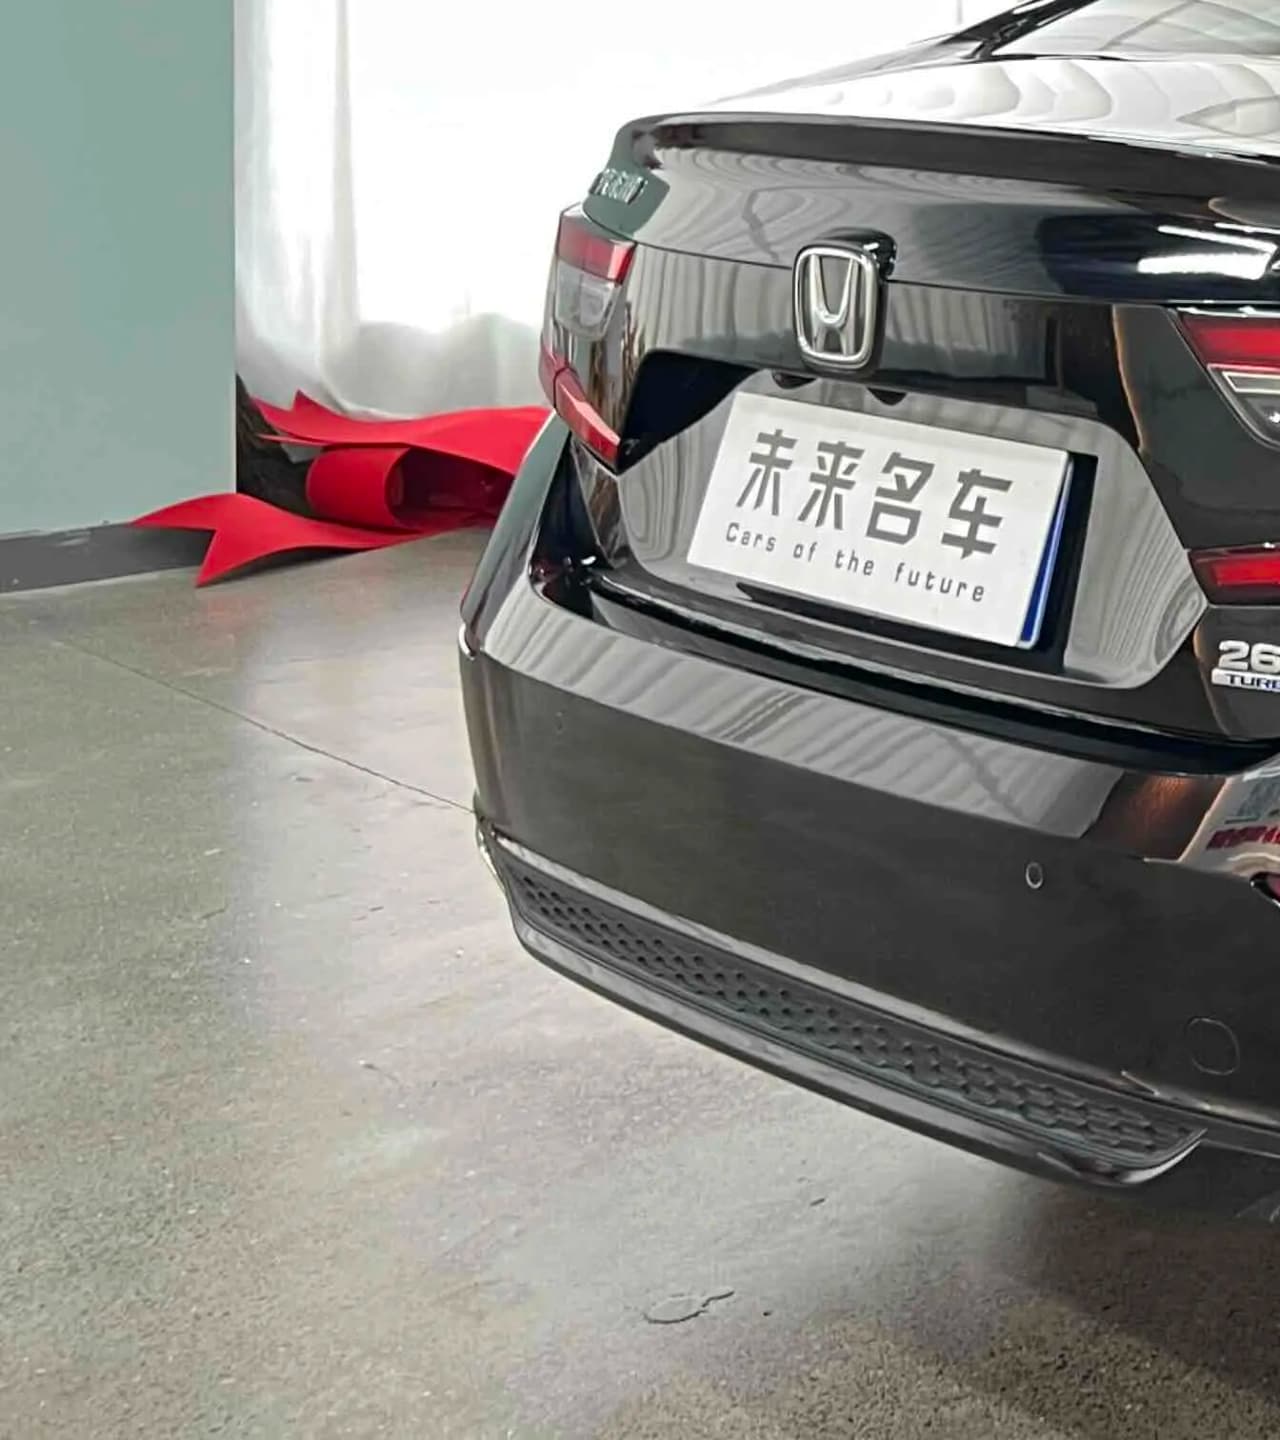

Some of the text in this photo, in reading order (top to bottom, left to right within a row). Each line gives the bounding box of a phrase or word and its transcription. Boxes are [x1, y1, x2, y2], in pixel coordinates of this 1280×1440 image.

[736, 428, 1015, 560] 未来名车
[725, 521, 986, 603] Cars of the future
